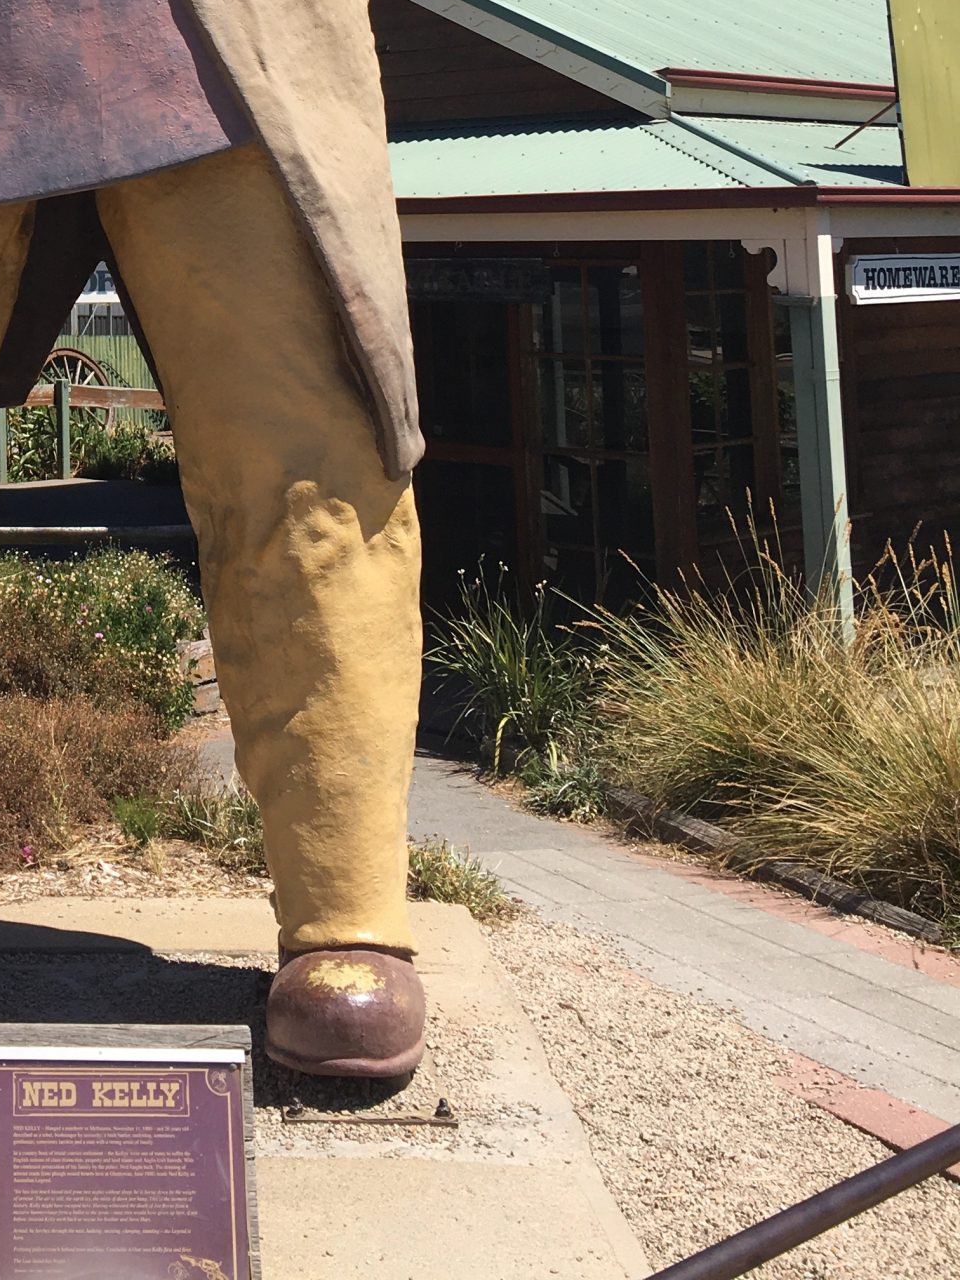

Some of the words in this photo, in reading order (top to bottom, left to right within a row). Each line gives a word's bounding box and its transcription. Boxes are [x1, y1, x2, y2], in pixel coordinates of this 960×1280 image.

[863, 265, 960, 290] HOMEWARE
[22, 1081, 77, 1107] NED
[92, 1081, 180, 1107] KELLY
